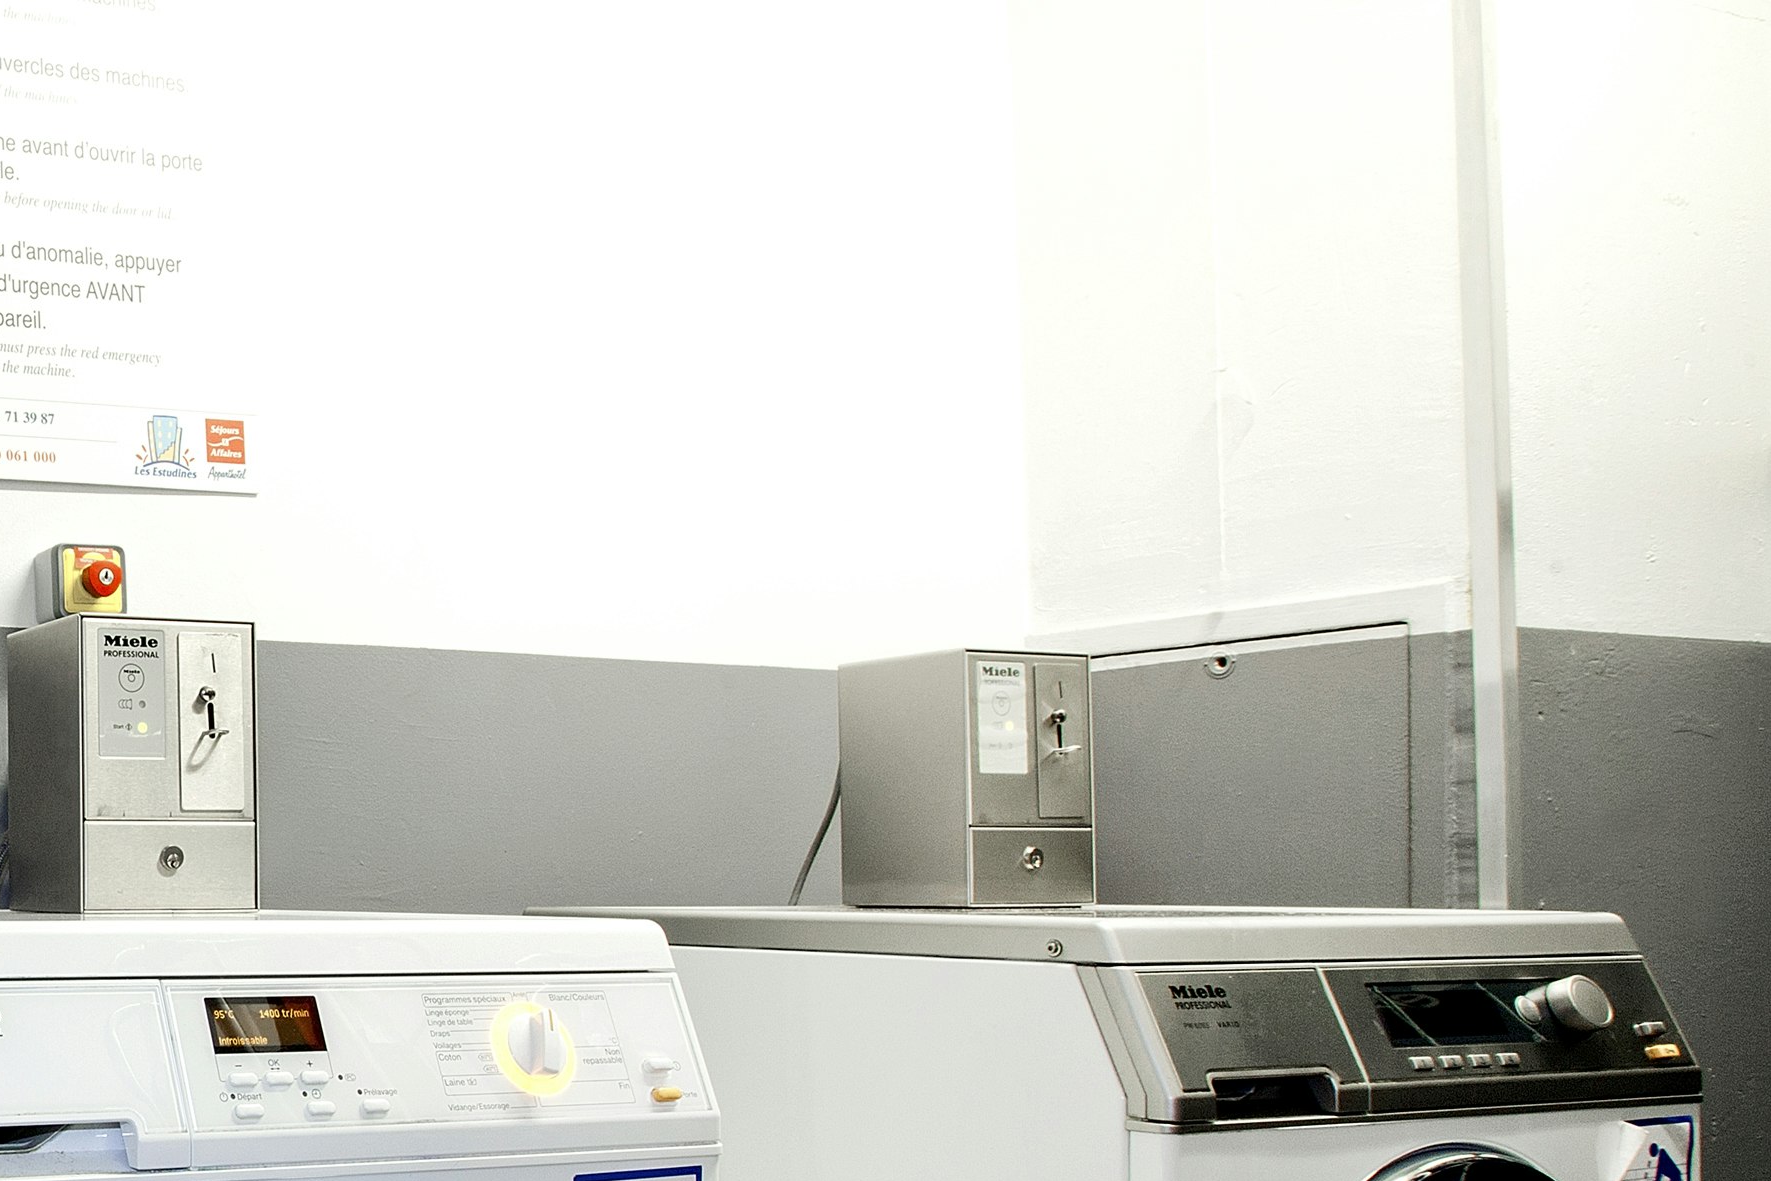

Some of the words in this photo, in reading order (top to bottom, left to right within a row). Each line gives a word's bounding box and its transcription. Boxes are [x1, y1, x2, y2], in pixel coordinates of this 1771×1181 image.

[70, 62, 100, 82] des
[22, 137, 69, 158] avant
[142, 148, 155, 167] la
[161, 153, 203, 172] porte
[4, 192, 40, 208] before
[43, 198, 89, 213] opening
[115, 253, 182, 276] appuyer
[86, 281, 146, 303] AVANT
[26, 343, 57, 358] press
[60, 343, 77, 358] the
[80, 347, 99, 360] red
[102, 351, 162, 367] emergency
[2, 360, 19, 374] the
[22, 363, 76, 378] machine.
[6, 410, 19, 423] 71
[23, 411, 37, 424] 39
[40, 411, 55, 425] 87
[210, 425, 240, 435] Séjours
[7, 449, 28, 462] 061
[33, 450, 56, 463] 000
[210, 448, 243, 459] Affaires
[134, 466, 150, 476] Les
[153, 467, 197, 478] Estudines
[103, 635, 158, 648] Miele
[103, 650, 159, 658] PROFESSIONAL
[982, 666, 1020, 677] Miele
[1168, 984, 1227, 999] Miele
[424, 996, 471, 1005] Programmes
[472, 996, 506, 1004] spéciaux
[548, 993, 604, 1002] Blanc/Couleurs
[1175, 1000, 1232, 1010] PROFESSIONAL
[259, 1009, 280, 1019] 1400
[282, 1008, 310, 1018] tr/min
[425, 1009, 443, 1017] Linge
[444, 1009, 469, 1017] éponge
[430, 1030, 451, 1038] Draps
[433, 1042, 462, 1050] Voilages
[604, 1048, 620, 1056] Non
[438, 1053, 462, 1062] Coton
[582, 1056, 622, 1066] repassable
[444, 1078, 466, 1087] Laine
[618, 1082, 630, 1090] Fin
[237, 1093, 262, 1102] Départ
[363, 1088, 398, 1097] Prélavage
[447, 1103, 510, 1112] Vidange/Essorage
